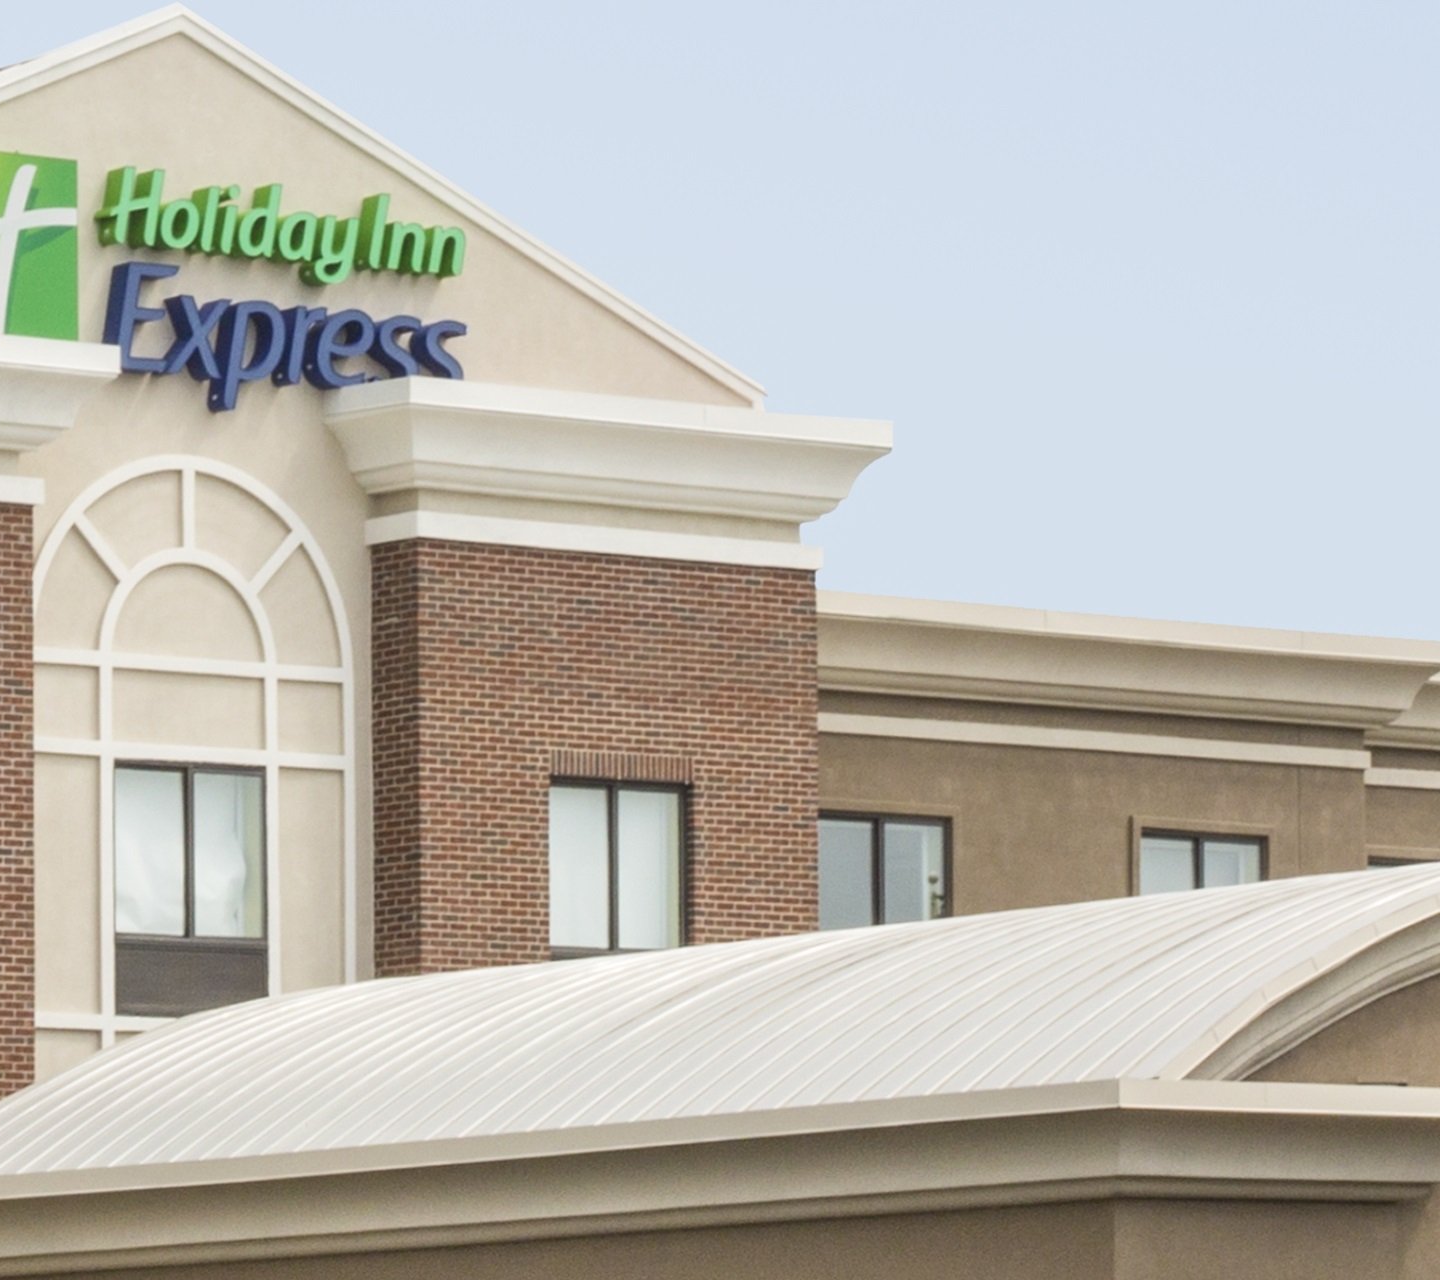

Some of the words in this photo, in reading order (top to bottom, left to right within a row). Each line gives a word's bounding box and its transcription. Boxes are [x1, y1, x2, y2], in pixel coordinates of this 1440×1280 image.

[94, 166, 357, 284] Holiday
[353, 192, 465, 277] Inn
[102, 261, 467, 412] Express
